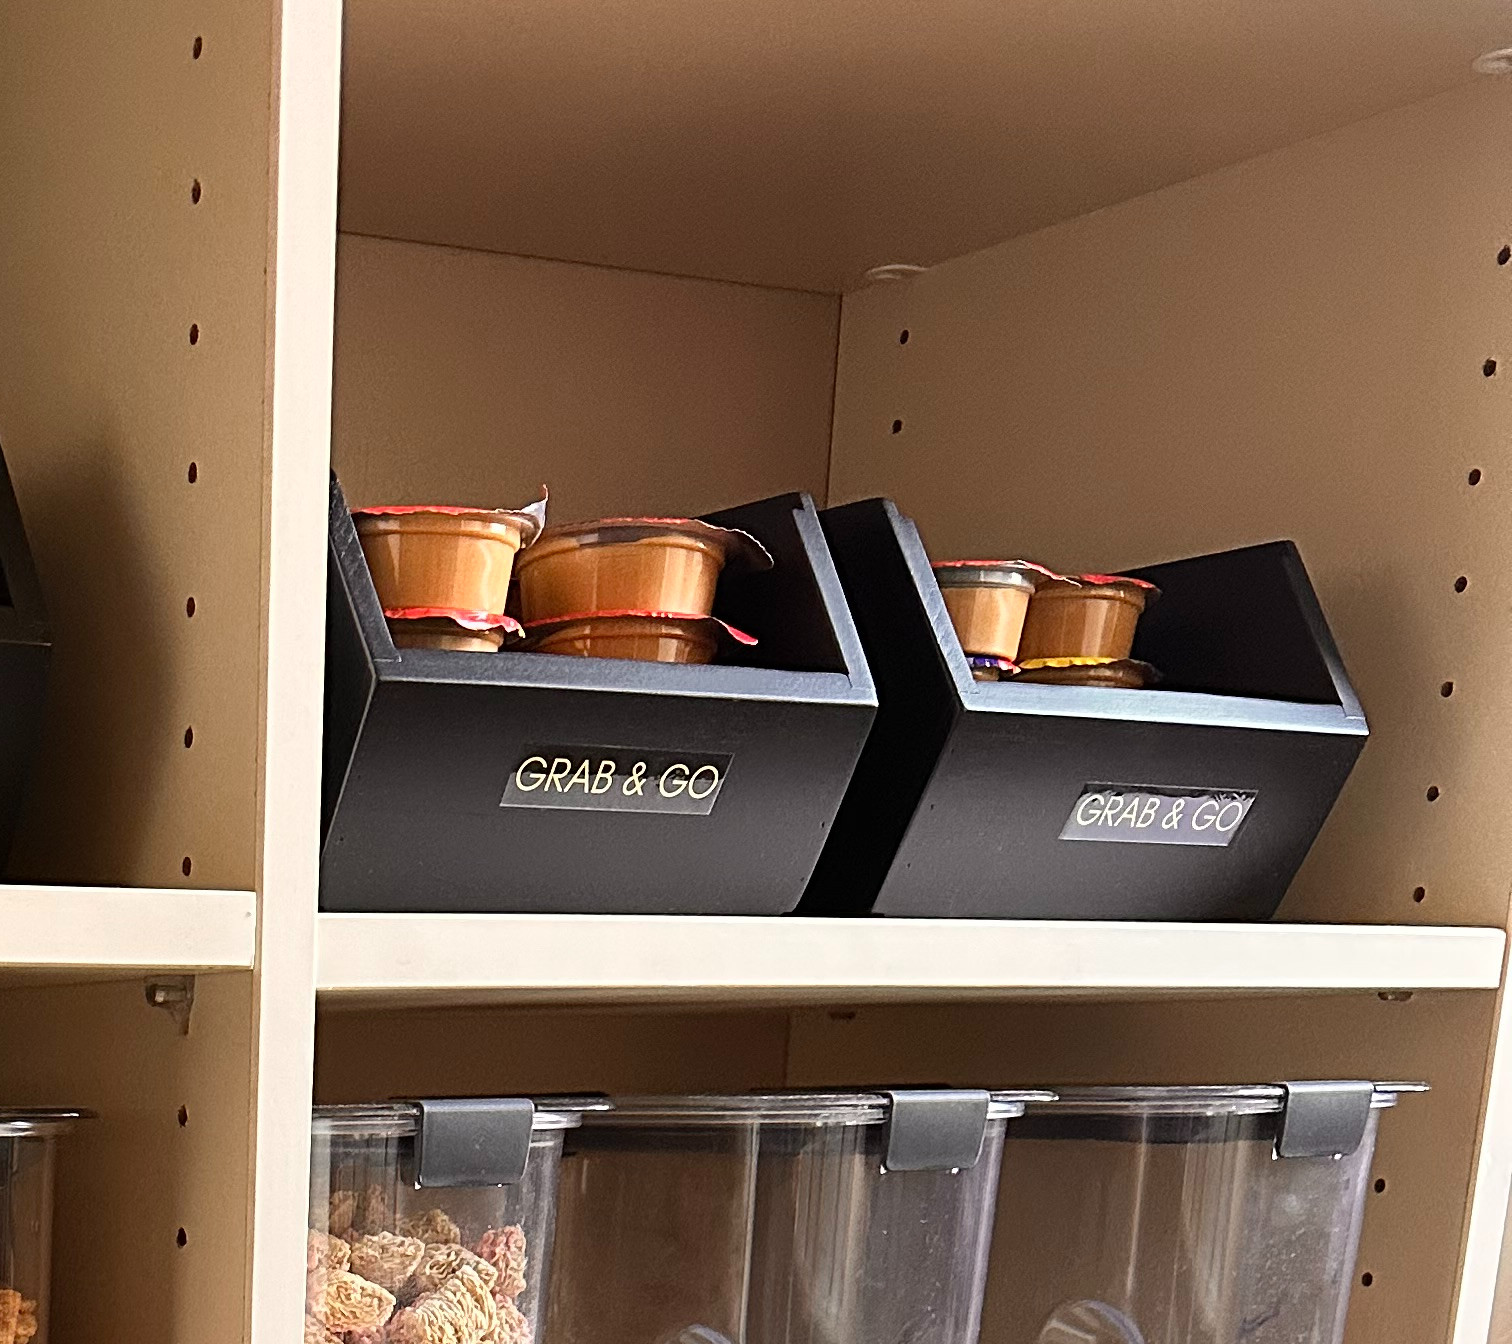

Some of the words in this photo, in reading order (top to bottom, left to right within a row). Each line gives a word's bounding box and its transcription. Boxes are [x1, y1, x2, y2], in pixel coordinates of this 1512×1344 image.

[515, 756, 616, 794] GRAB
[622, 761, 647, 796] &
[659, 763, 719, 800] GO
[1076, 794, 1161, 828] GRAB
[1161, 799, 1186, 830] &
[1191, 800, 1243, 832] GO
